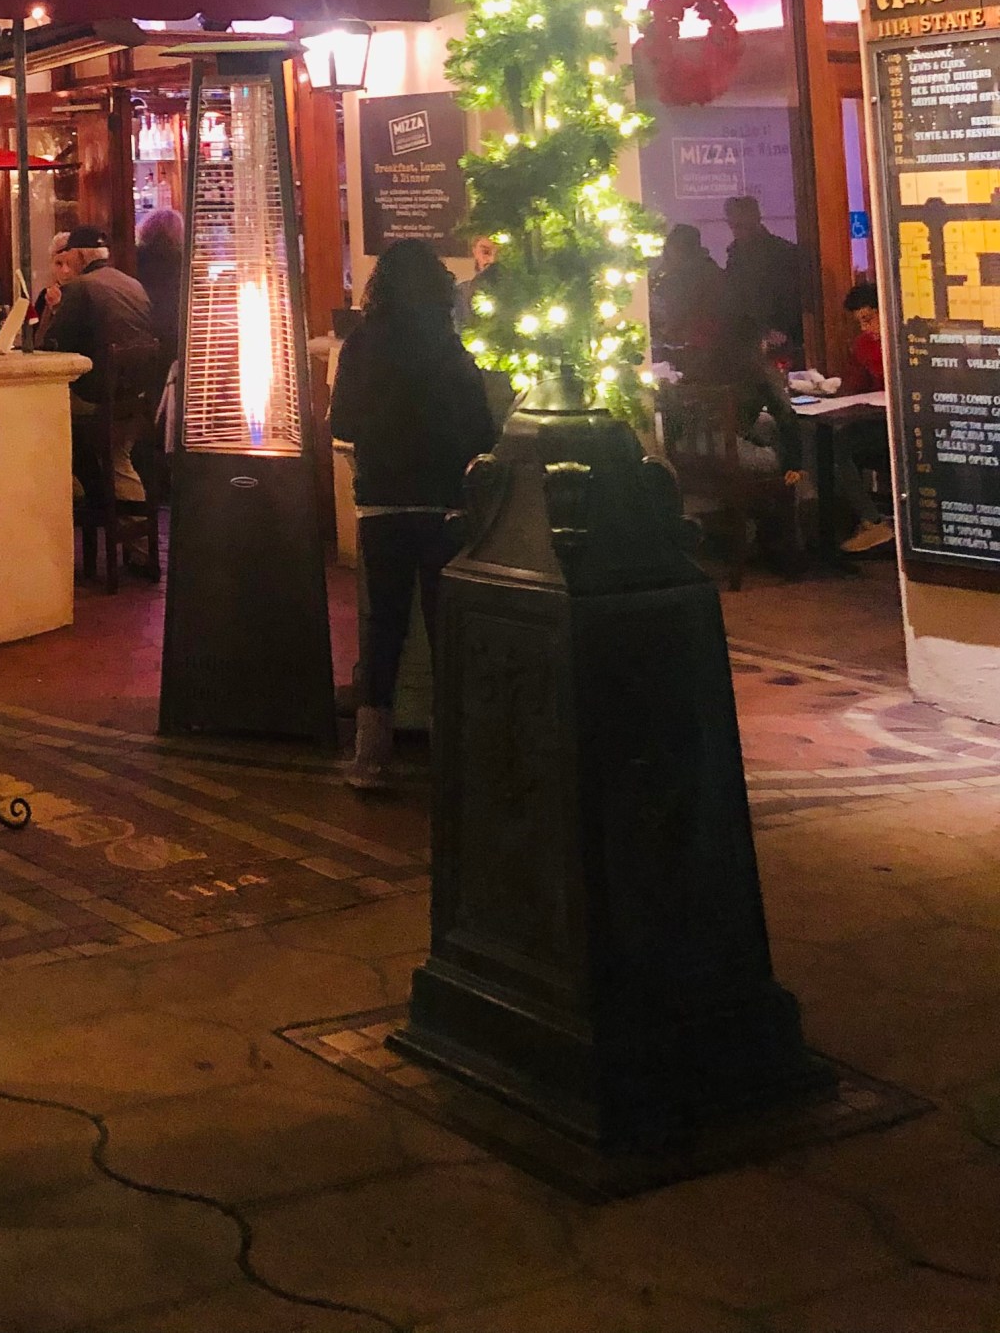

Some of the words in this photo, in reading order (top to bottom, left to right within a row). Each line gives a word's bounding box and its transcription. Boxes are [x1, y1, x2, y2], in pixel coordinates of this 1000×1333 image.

[878, 18, 911, 37] 1114
[920, 8, 985, 33] STATE
[909, 62, 931, 73] LEWIS
[940, 59, 966, 69] CLARK
[953, 69, 992, 80] WINERY
[393, 116, 424, 135] MIZZA
[680, 144, 736, 165] MIZZA
[420, 161, 447, 172] Lunch
[400, 172, 430, 182] Dinner
